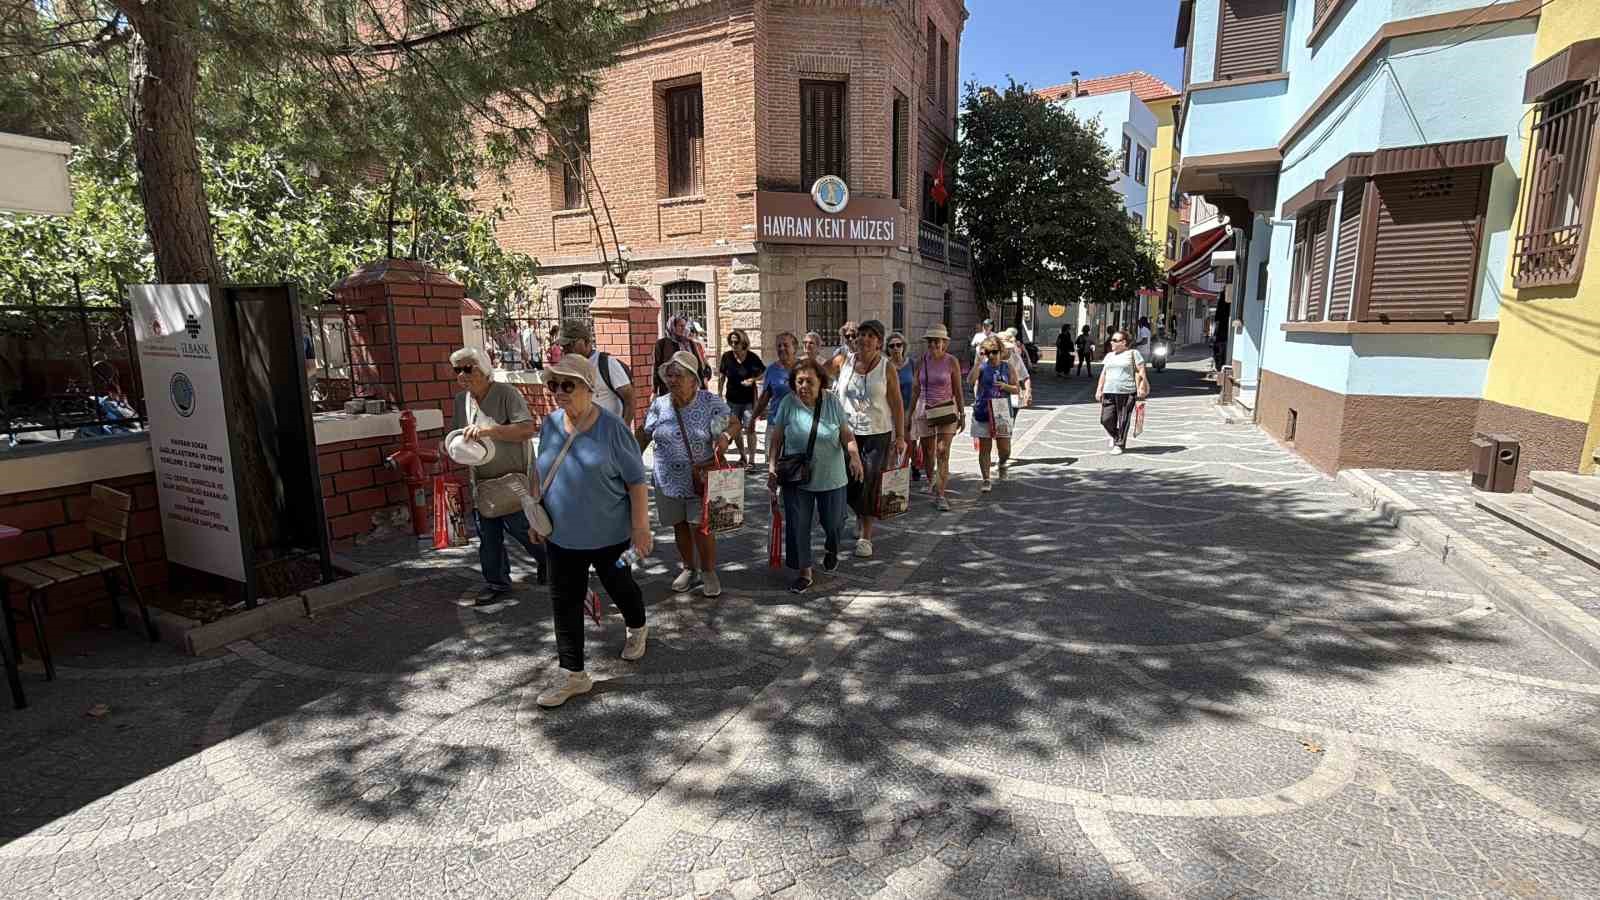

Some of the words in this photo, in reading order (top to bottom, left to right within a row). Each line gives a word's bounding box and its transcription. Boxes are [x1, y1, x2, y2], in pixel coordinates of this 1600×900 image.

[763, 215, 812, 238] HAVRAN
[815, 218, 846, 239] KENT
[850, 215, 894, 241] MÜZESİ
